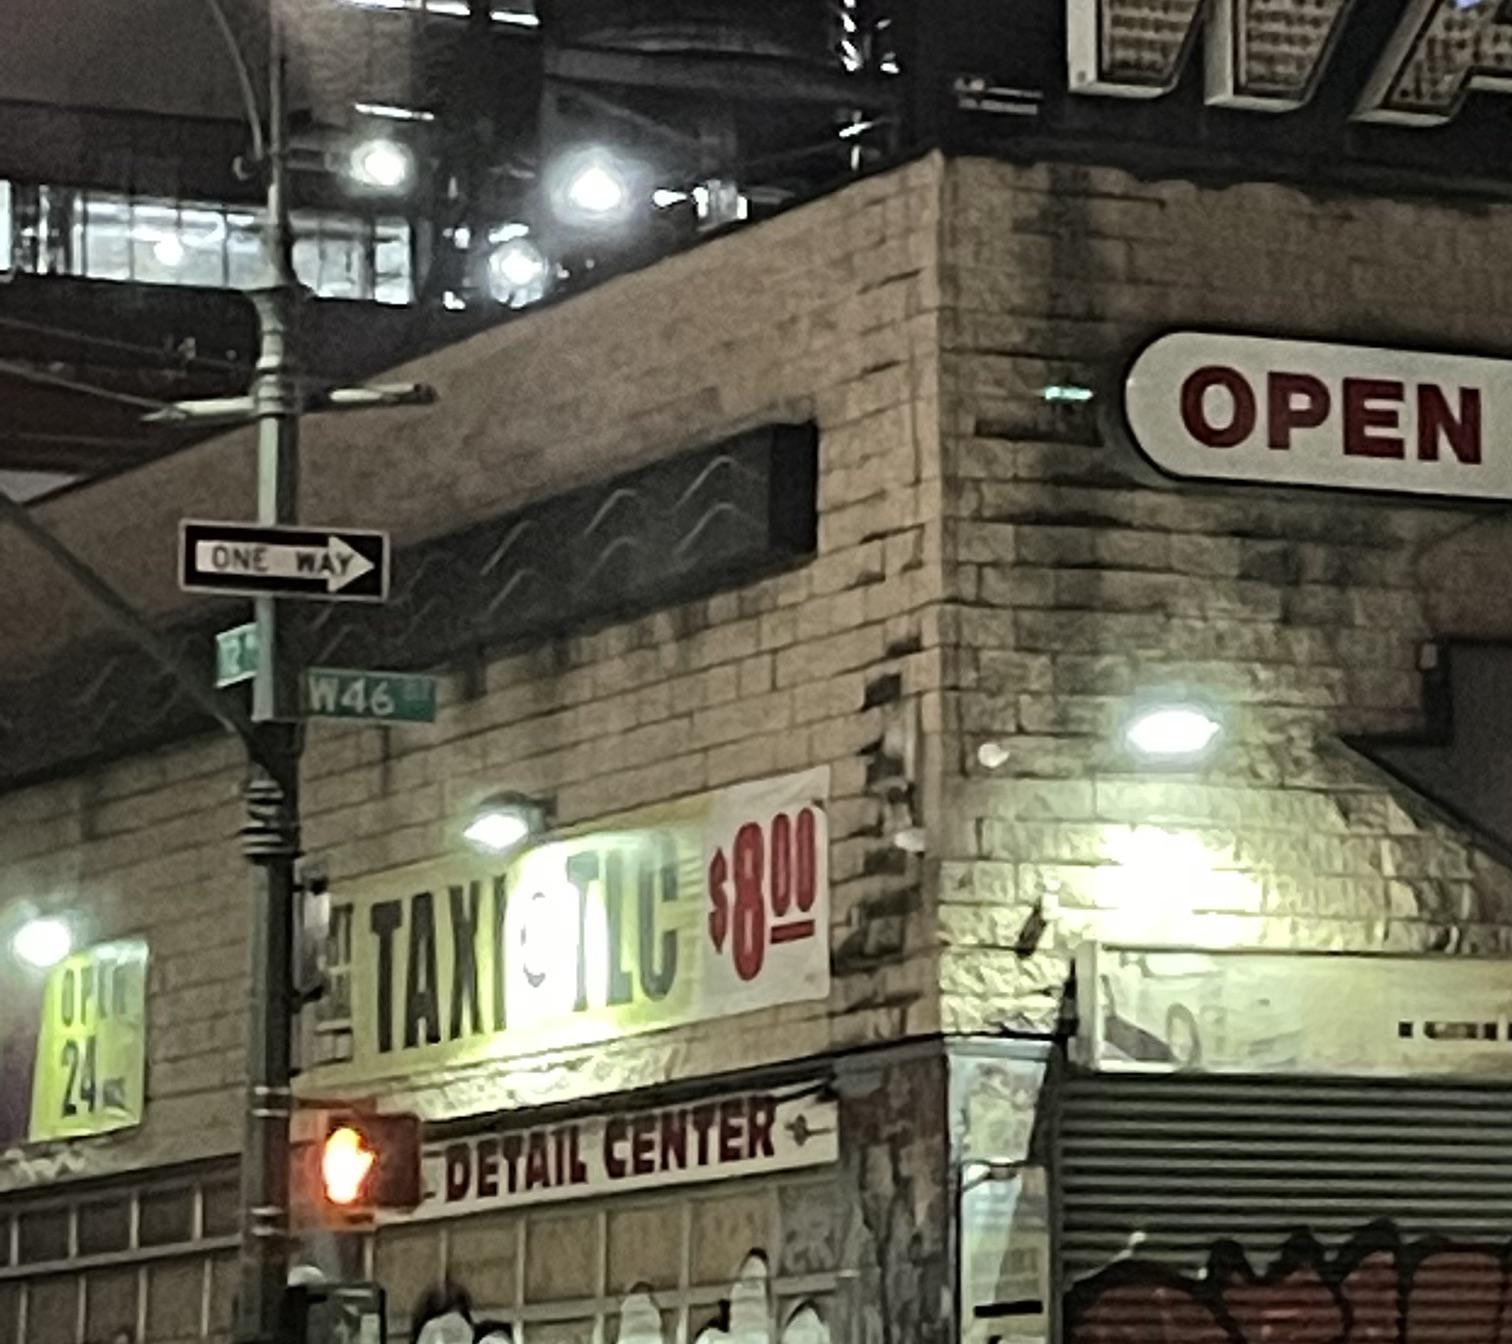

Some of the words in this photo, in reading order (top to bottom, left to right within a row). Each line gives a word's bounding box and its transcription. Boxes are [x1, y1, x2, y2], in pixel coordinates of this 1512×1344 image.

[1178, 365, 1483, 465] OPEN
[211, 545, 269, 572] ONE
[296, 551, 352, 576] WAY
[444, 1123, 590, 1203] DETAIL
[602, 1093, 778, 1181] CENTER
